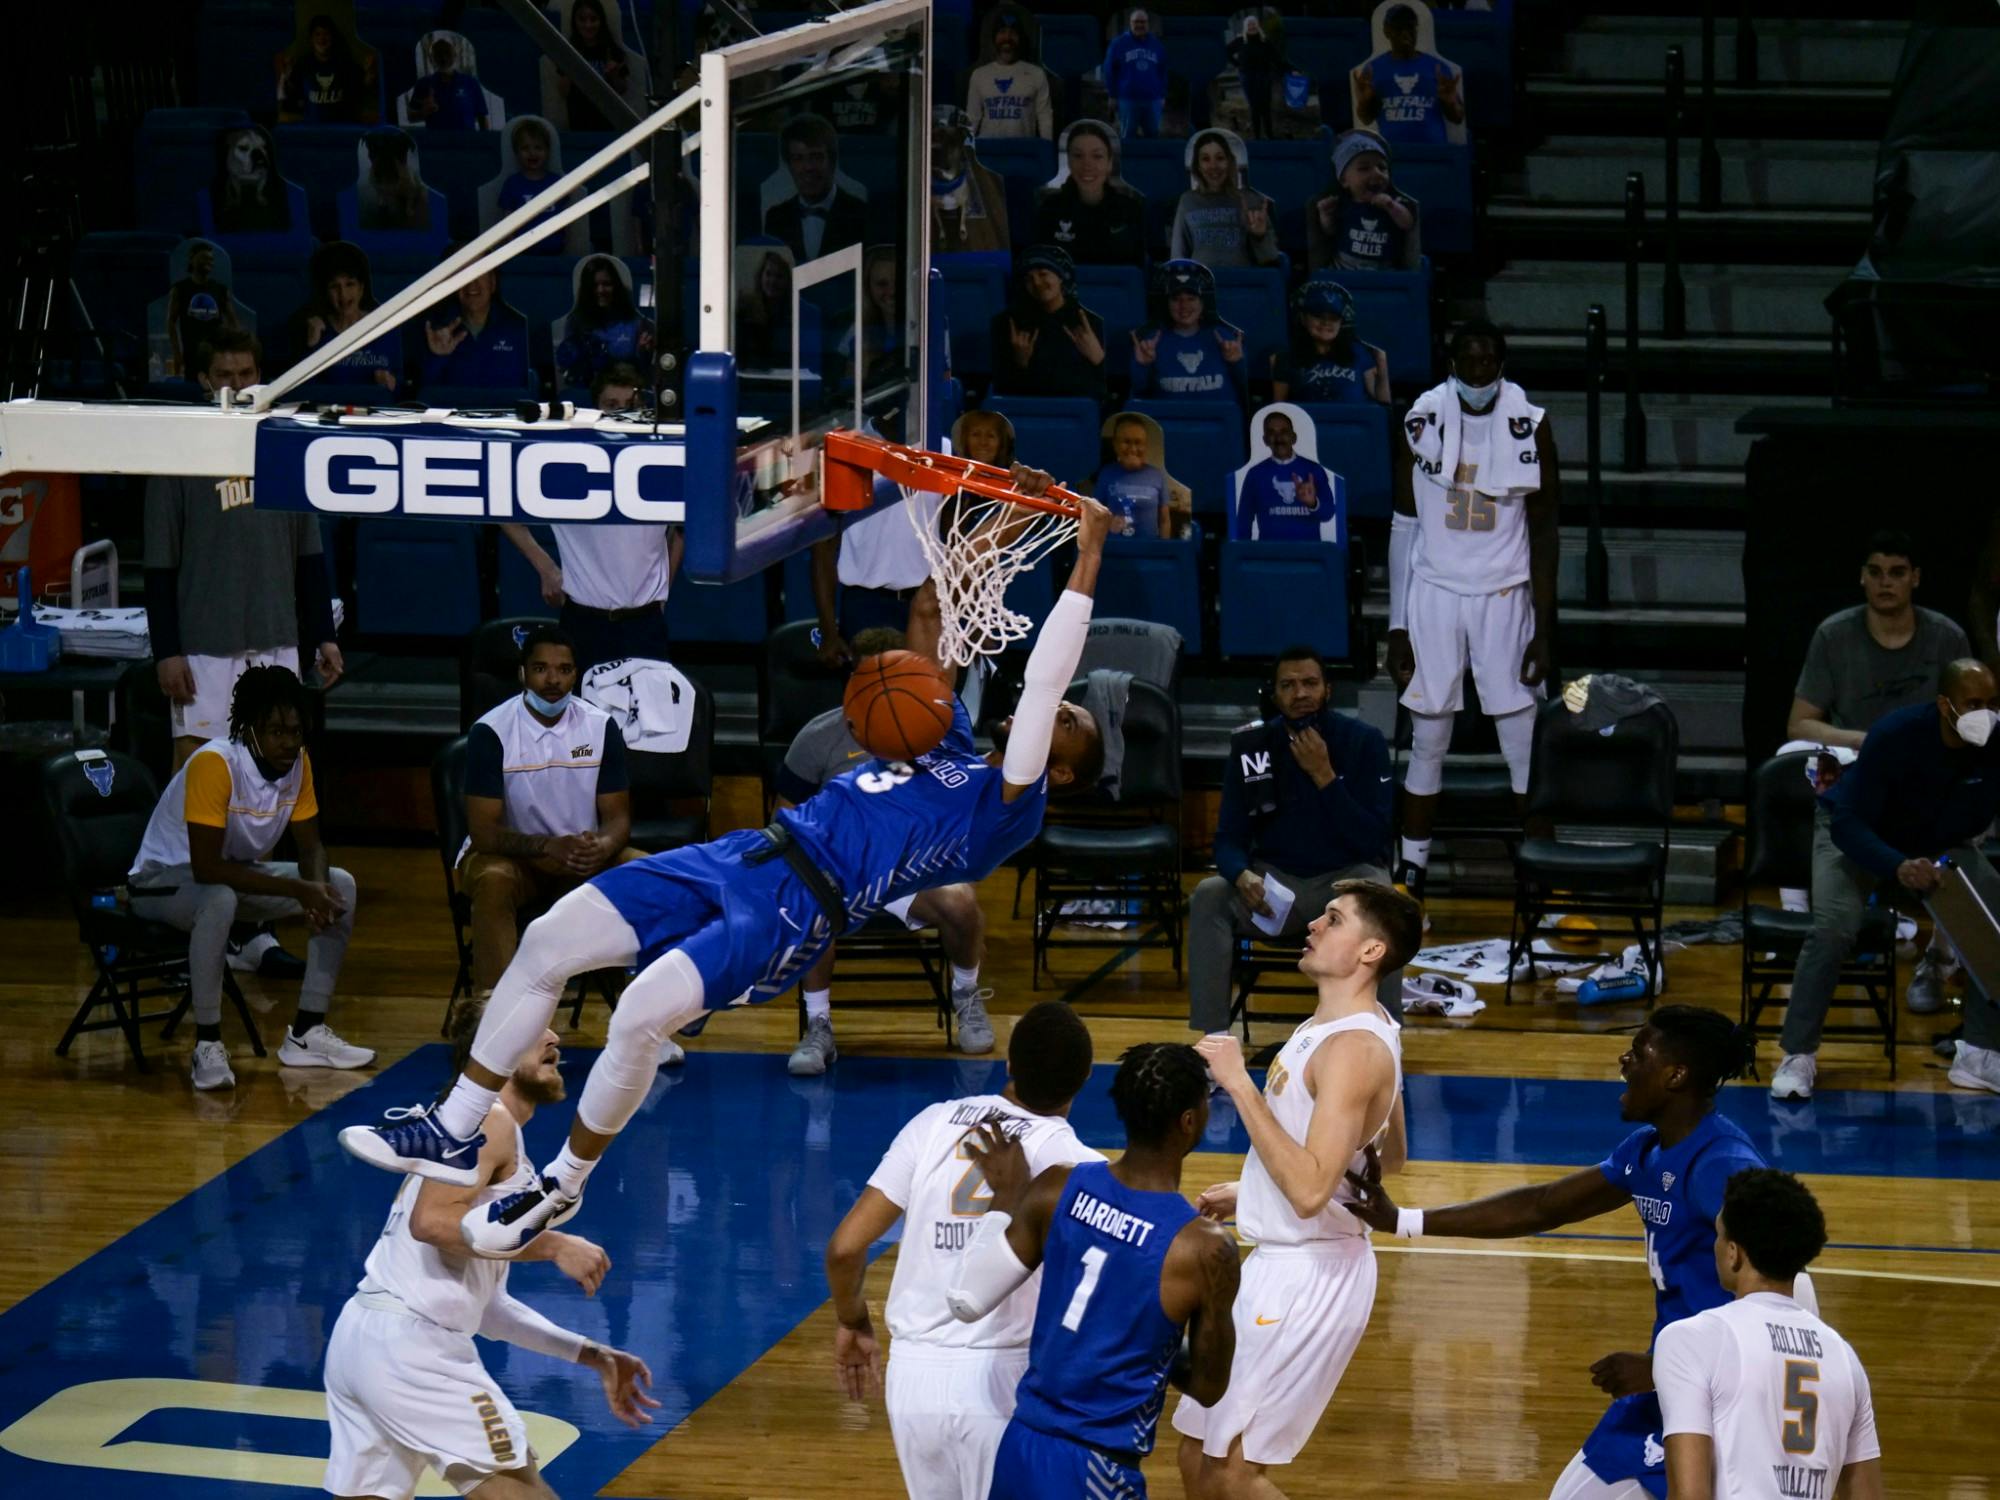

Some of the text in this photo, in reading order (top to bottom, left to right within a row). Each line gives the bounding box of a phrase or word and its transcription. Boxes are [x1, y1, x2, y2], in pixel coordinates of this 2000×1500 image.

[1385, 108, 1425, 122] BULLS
[1349, 227, 1389, 244] BUFFALO
[1352, 241, 1383, 257] BULLS
[1444, 487, 1496, 531] 35
[571, 747, 593, 758] TOLEDO
[1070, 1191, 1155, 1248] HARDNETT
[1061, 1245, 1109, 1334] 1
[1765, 1322, 1823, 1359] ROLLINS
[471, 1391, 517, 1463] TOLEDO
[1782, 1359, 1820, 1455] 5
